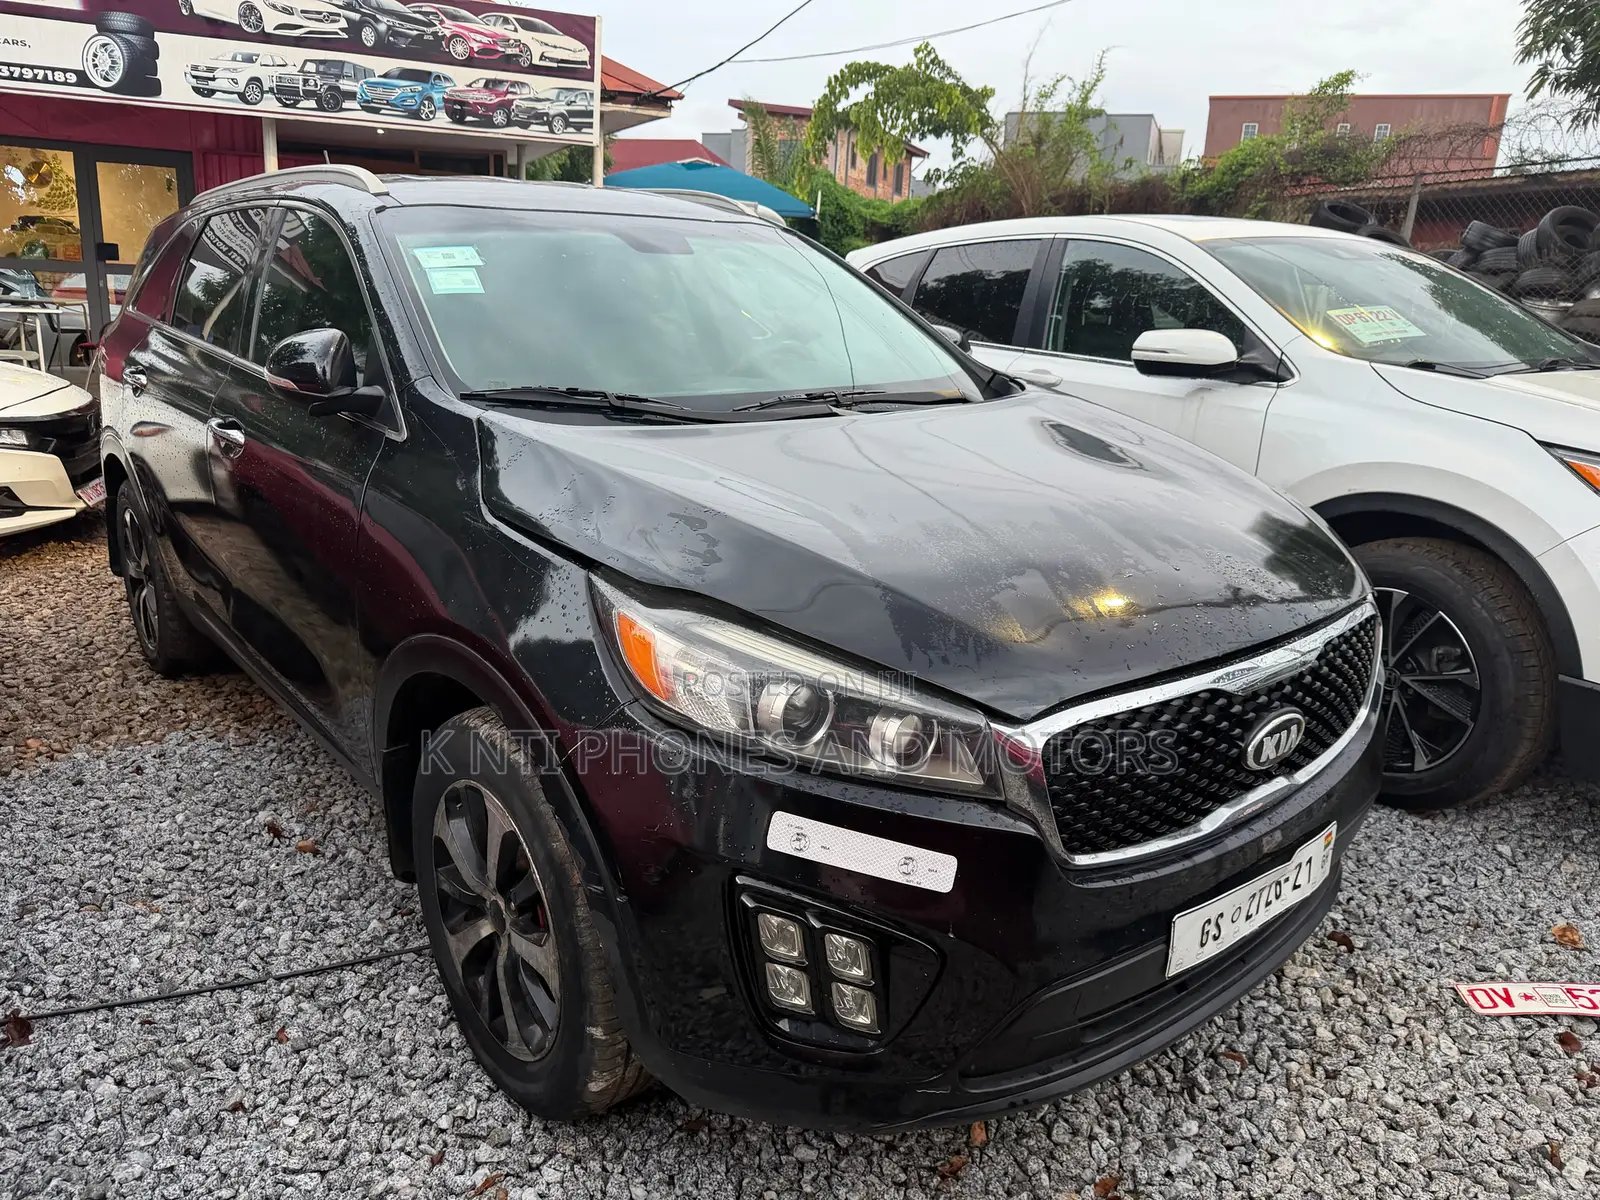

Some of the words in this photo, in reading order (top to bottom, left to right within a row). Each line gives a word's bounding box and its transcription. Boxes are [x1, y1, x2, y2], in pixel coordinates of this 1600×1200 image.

[0, 37, 31, 49] ARS,
[1259, 723, 1298, 763] KIA
[1200, 912, 1225, 949] GS
[1467, 987, 1515, 1010] DV
